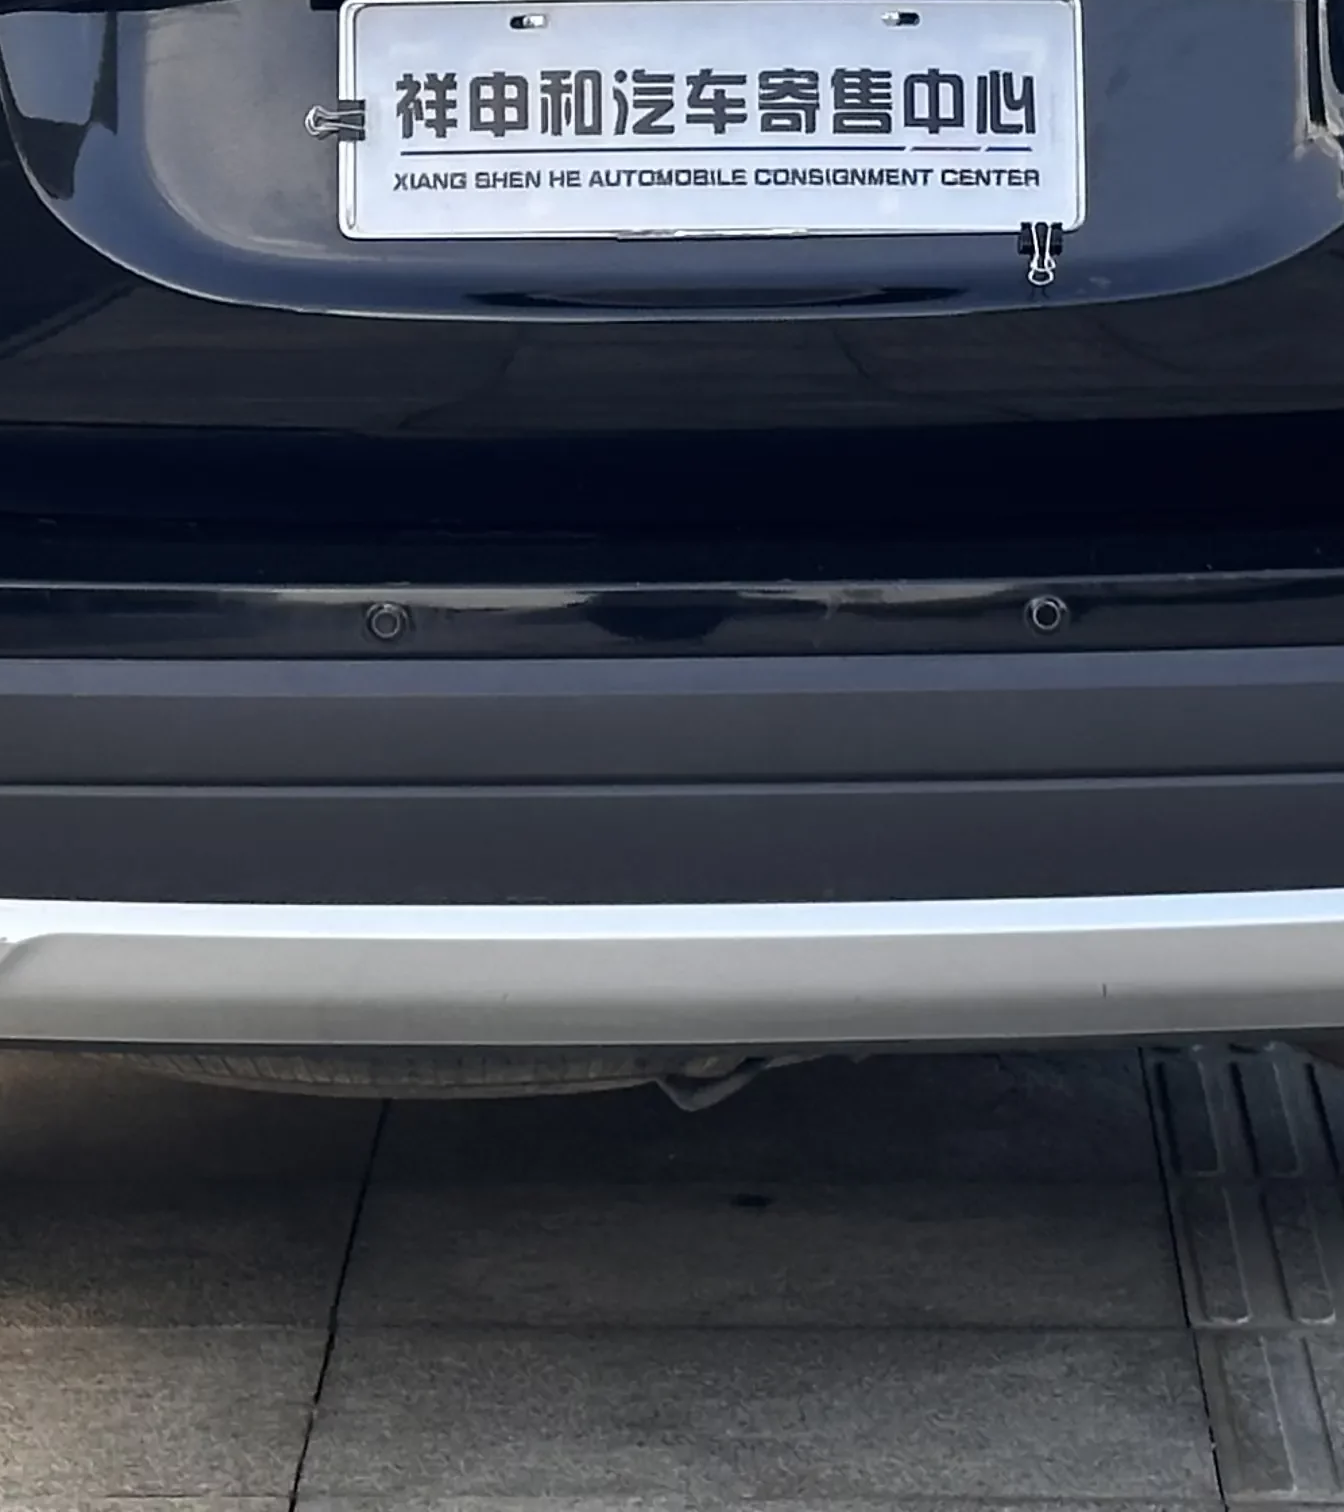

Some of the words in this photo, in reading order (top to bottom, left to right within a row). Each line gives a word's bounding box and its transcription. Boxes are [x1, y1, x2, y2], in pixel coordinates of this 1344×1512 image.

[395, 67, 1037, 139] 祥申和汽车寄售中心
[393, 171, 467, 191] XIANG
[474, 169, 541, 189] SHEN
[548, 169, 581, 188] HE
[588, 168, 748, 188] AUTOMOBILE
[754, 168, 934, 187] CONSIGNMENT
[940, 168, 1040, 187] CENTER
